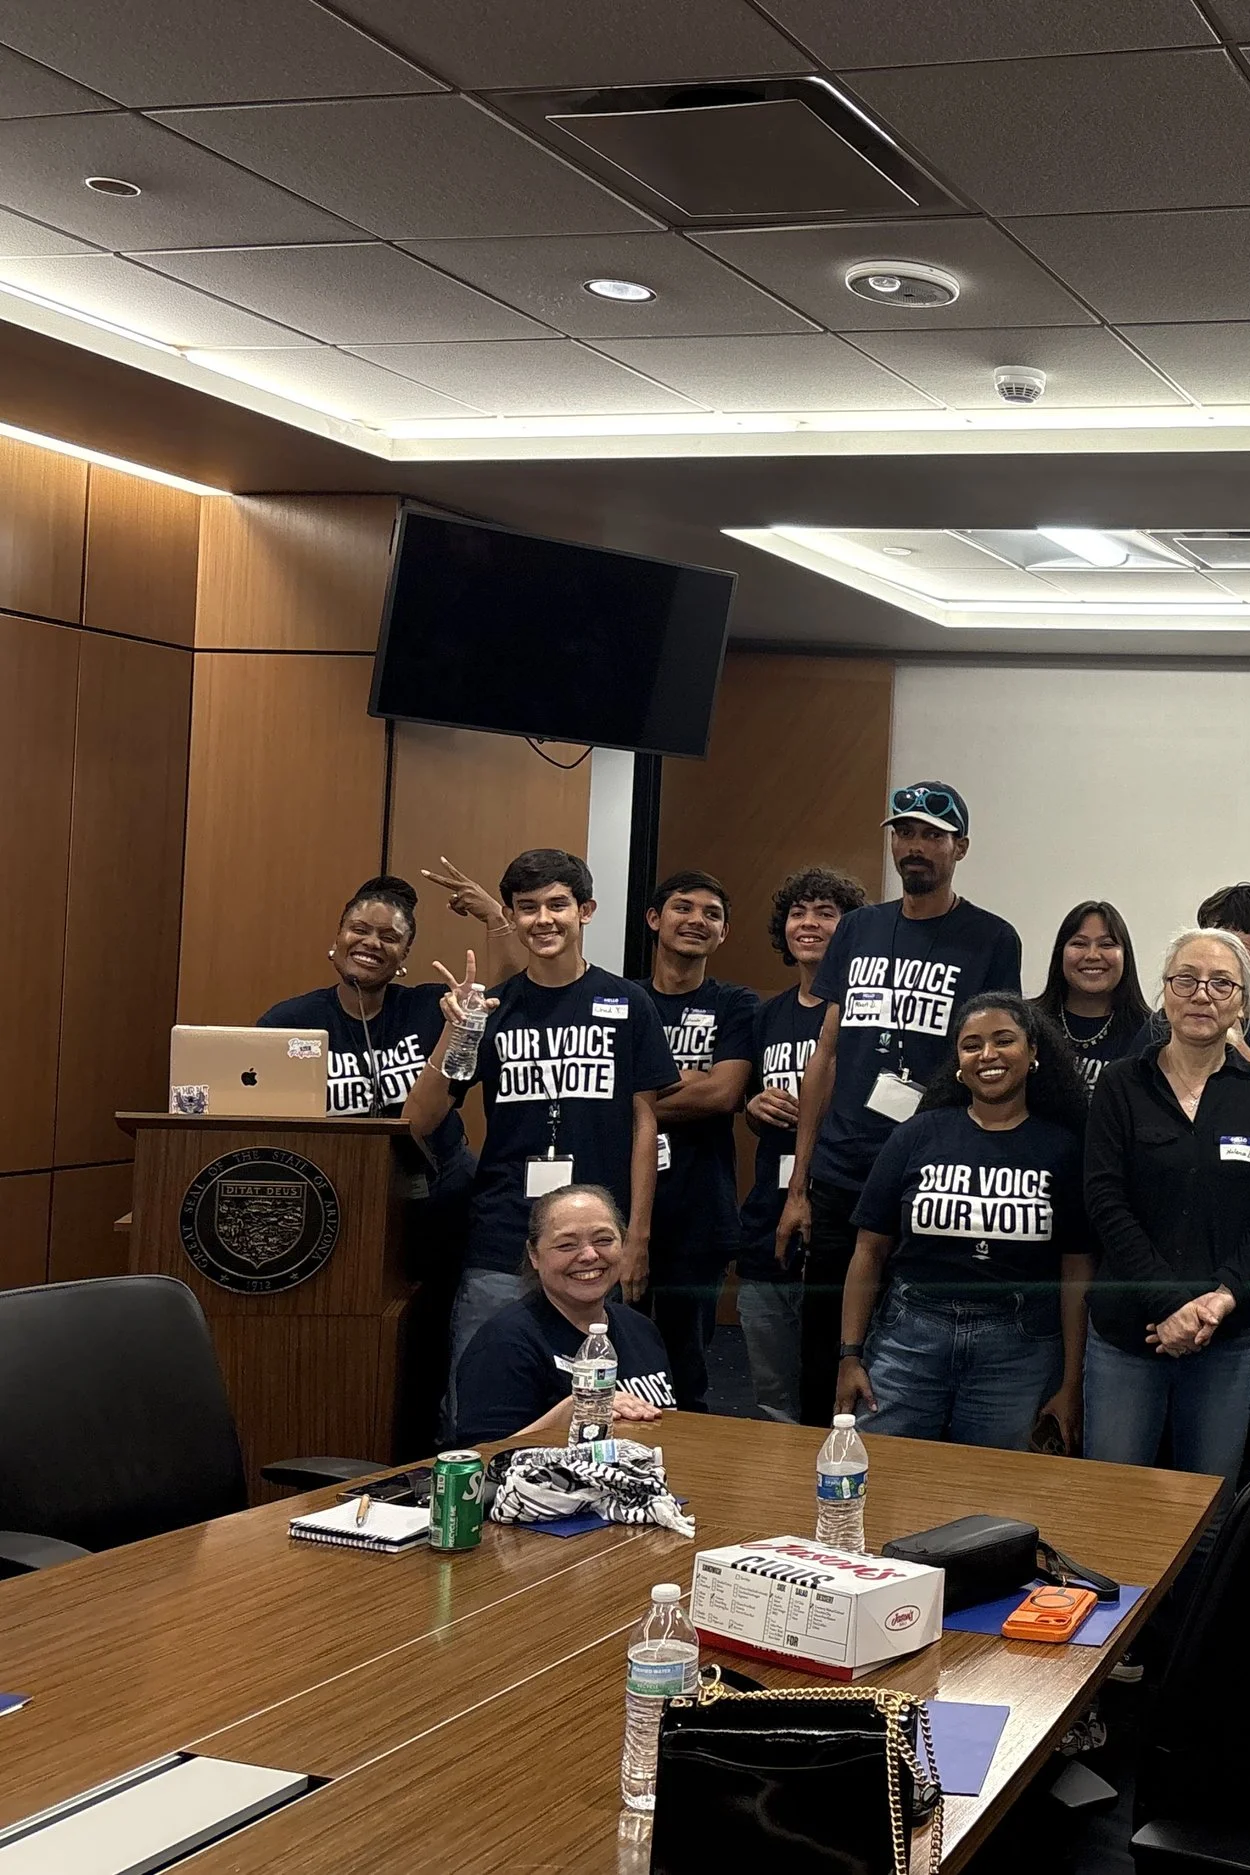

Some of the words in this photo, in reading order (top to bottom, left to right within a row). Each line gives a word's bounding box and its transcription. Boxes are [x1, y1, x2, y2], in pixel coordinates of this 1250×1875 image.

[849, 956, 890, 987] OUR
[893, 957, 961, 996] VOICE
[495, 1028, 540, 1062] OUR
[546, 1024, 617, 1058] VOICE
[763, 1041, 792, 1075] OUR
[327, 1050, 360, 1078] UR
[499, 1065, 546, 1097] OUR
[551, 1062, 611, 1093] VOTE
[327, 1081, 368, 1112] UR
[207, 1161, 225, 1177] OF
[232, 1150, 261, 1162] THE
[272, 1151, 309, 1174] STATE
[226, 1186, 261, 1195] DITAT
[266, 1187, 298, 1196] DEUS
[313, 1175, 329, 1191] OF
[918, 1164, 972, 1194] OUR
[979, 1166, 1053, 1199] VOICE
[184, 1182, 205, 1214] SEAL
[311, 1200, 337, 1261] ARIZONA
[917, 1198, 972, 1231] OUR
[981, 1202, 1048, 1235] VOTE
[739, 1543, 908, 1581] Jason's
[786, 1634, 799, 1647] FOR
